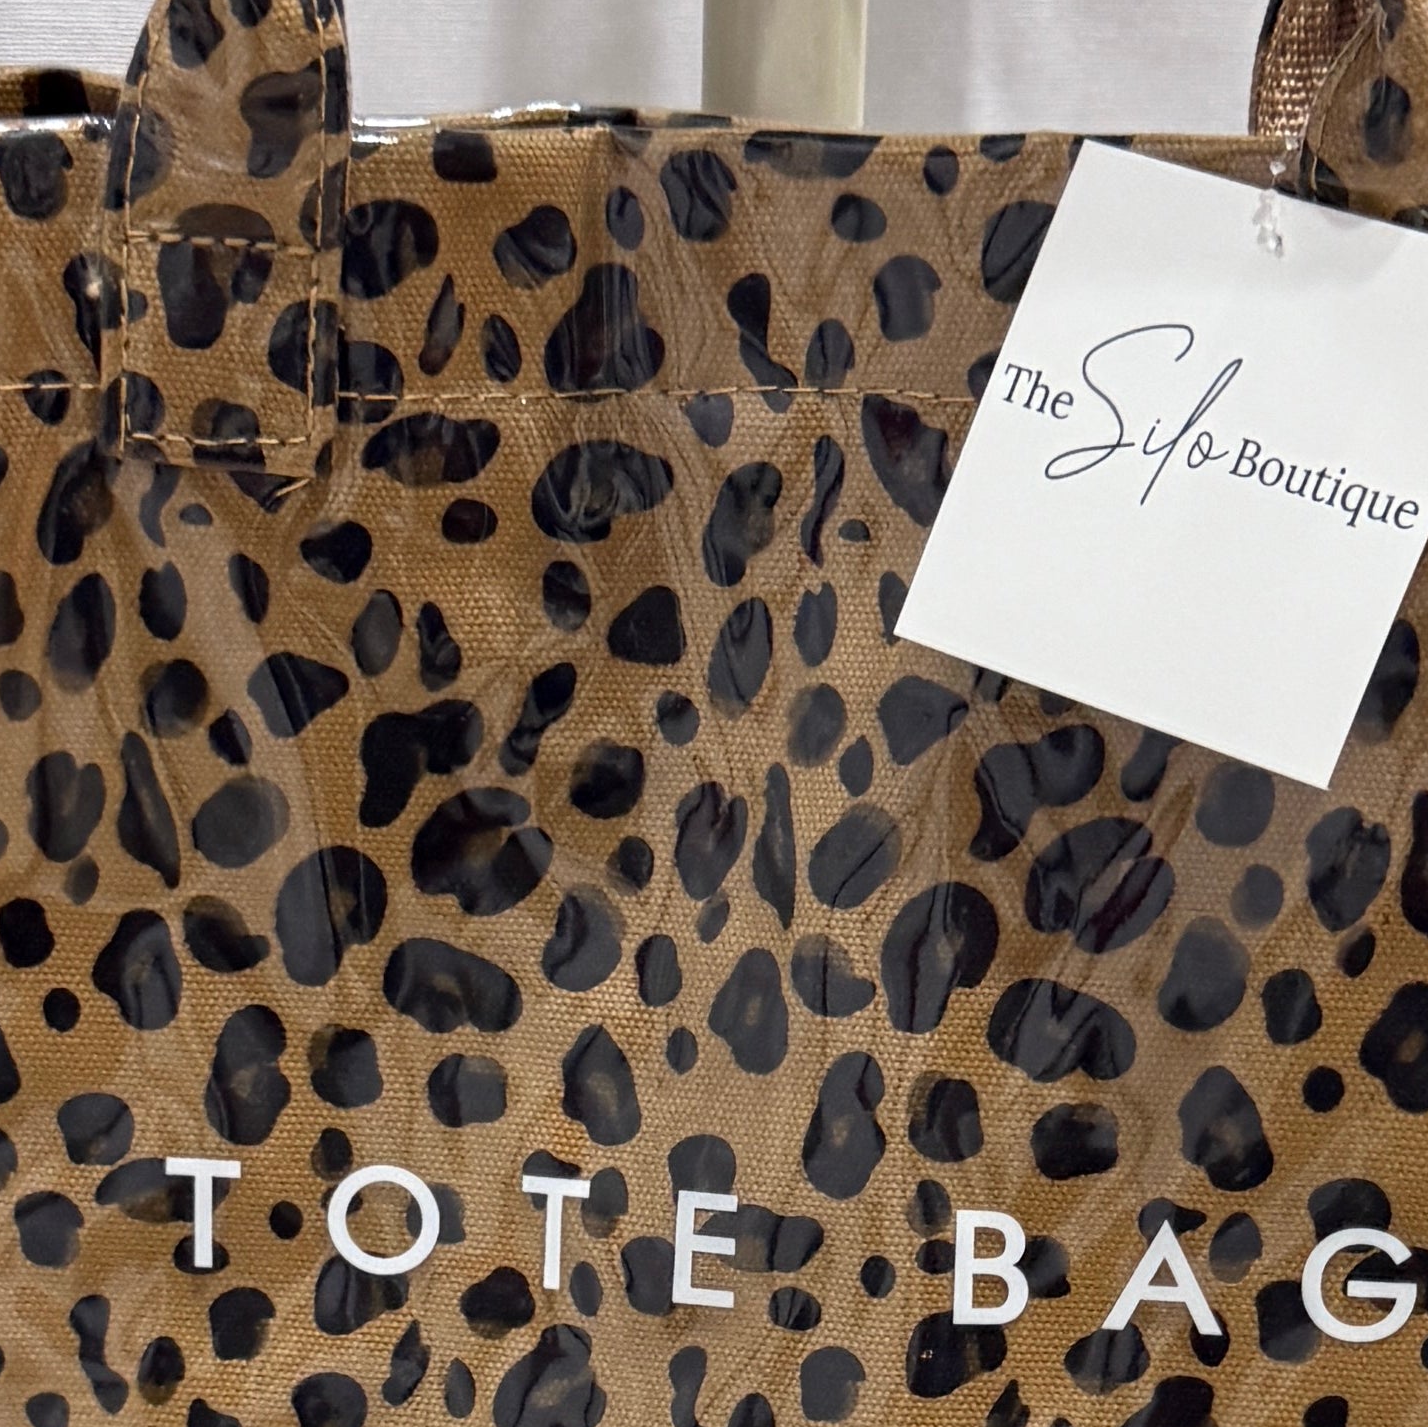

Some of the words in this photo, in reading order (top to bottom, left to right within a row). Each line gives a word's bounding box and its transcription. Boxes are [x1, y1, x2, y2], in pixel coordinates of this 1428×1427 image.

[1002, 363, 1074, 420] The
[1044, 323, 1244, 506] Silo
[1228, 437, 1420, 530] Boutique
[165, 1155, 739, 1309] TOTE
[952, 1209, 1418, 1343] BAG
